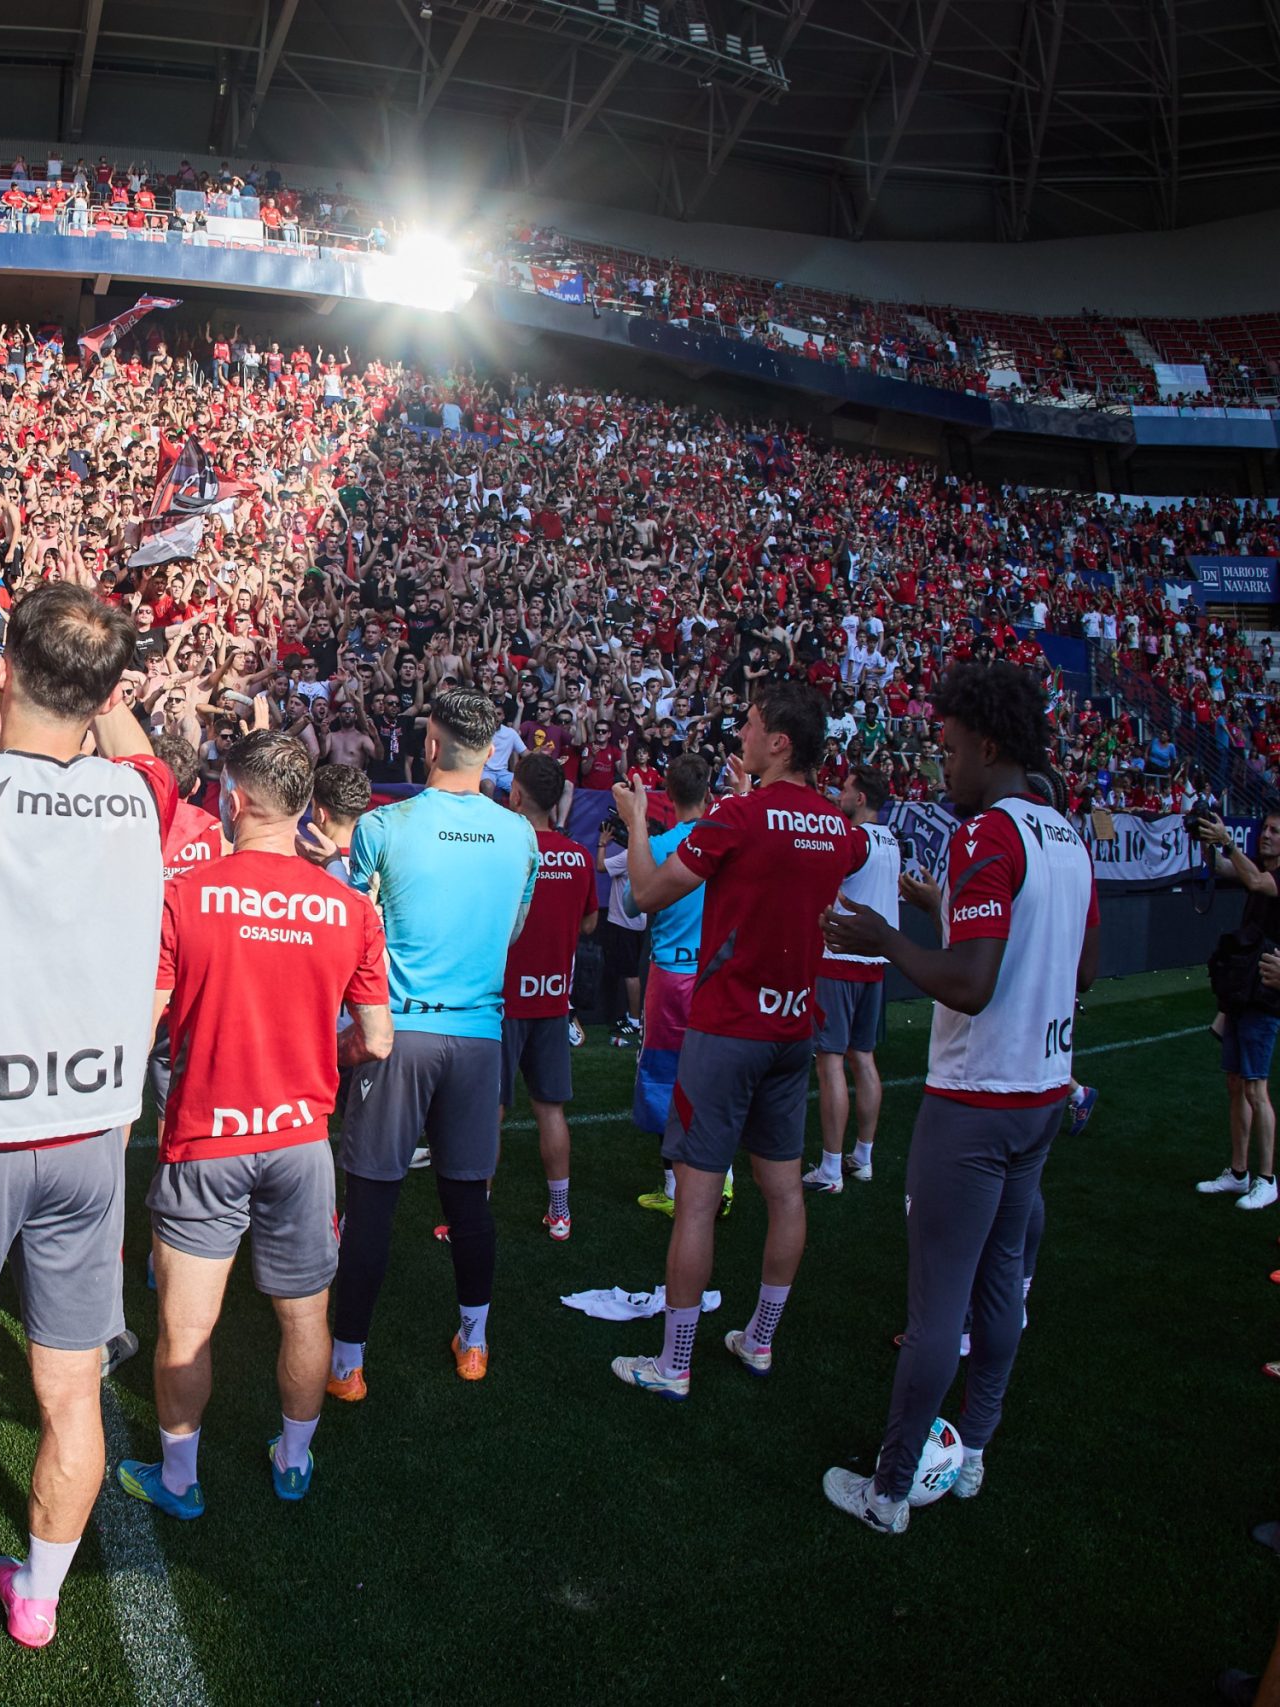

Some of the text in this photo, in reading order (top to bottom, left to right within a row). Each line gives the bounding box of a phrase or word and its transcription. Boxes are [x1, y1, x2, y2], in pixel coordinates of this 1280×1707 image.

[1203, 570, 1218, 582] DN
[1222, 566, 1269, 578] DIARIO DE
[1224, 580, 1272, 593] NAVARRA
[17, 789, 147, 819] macron
[766, 809, 847, 837] macron
[438, 831, 495, 843] OSASUNA
[793, 838, 835, 852] OSASUNA
[201, 885, 347, 927] macron
[239, 925, 313, 945] OSASUNA
[520, 973, 567, 998] DIGI
